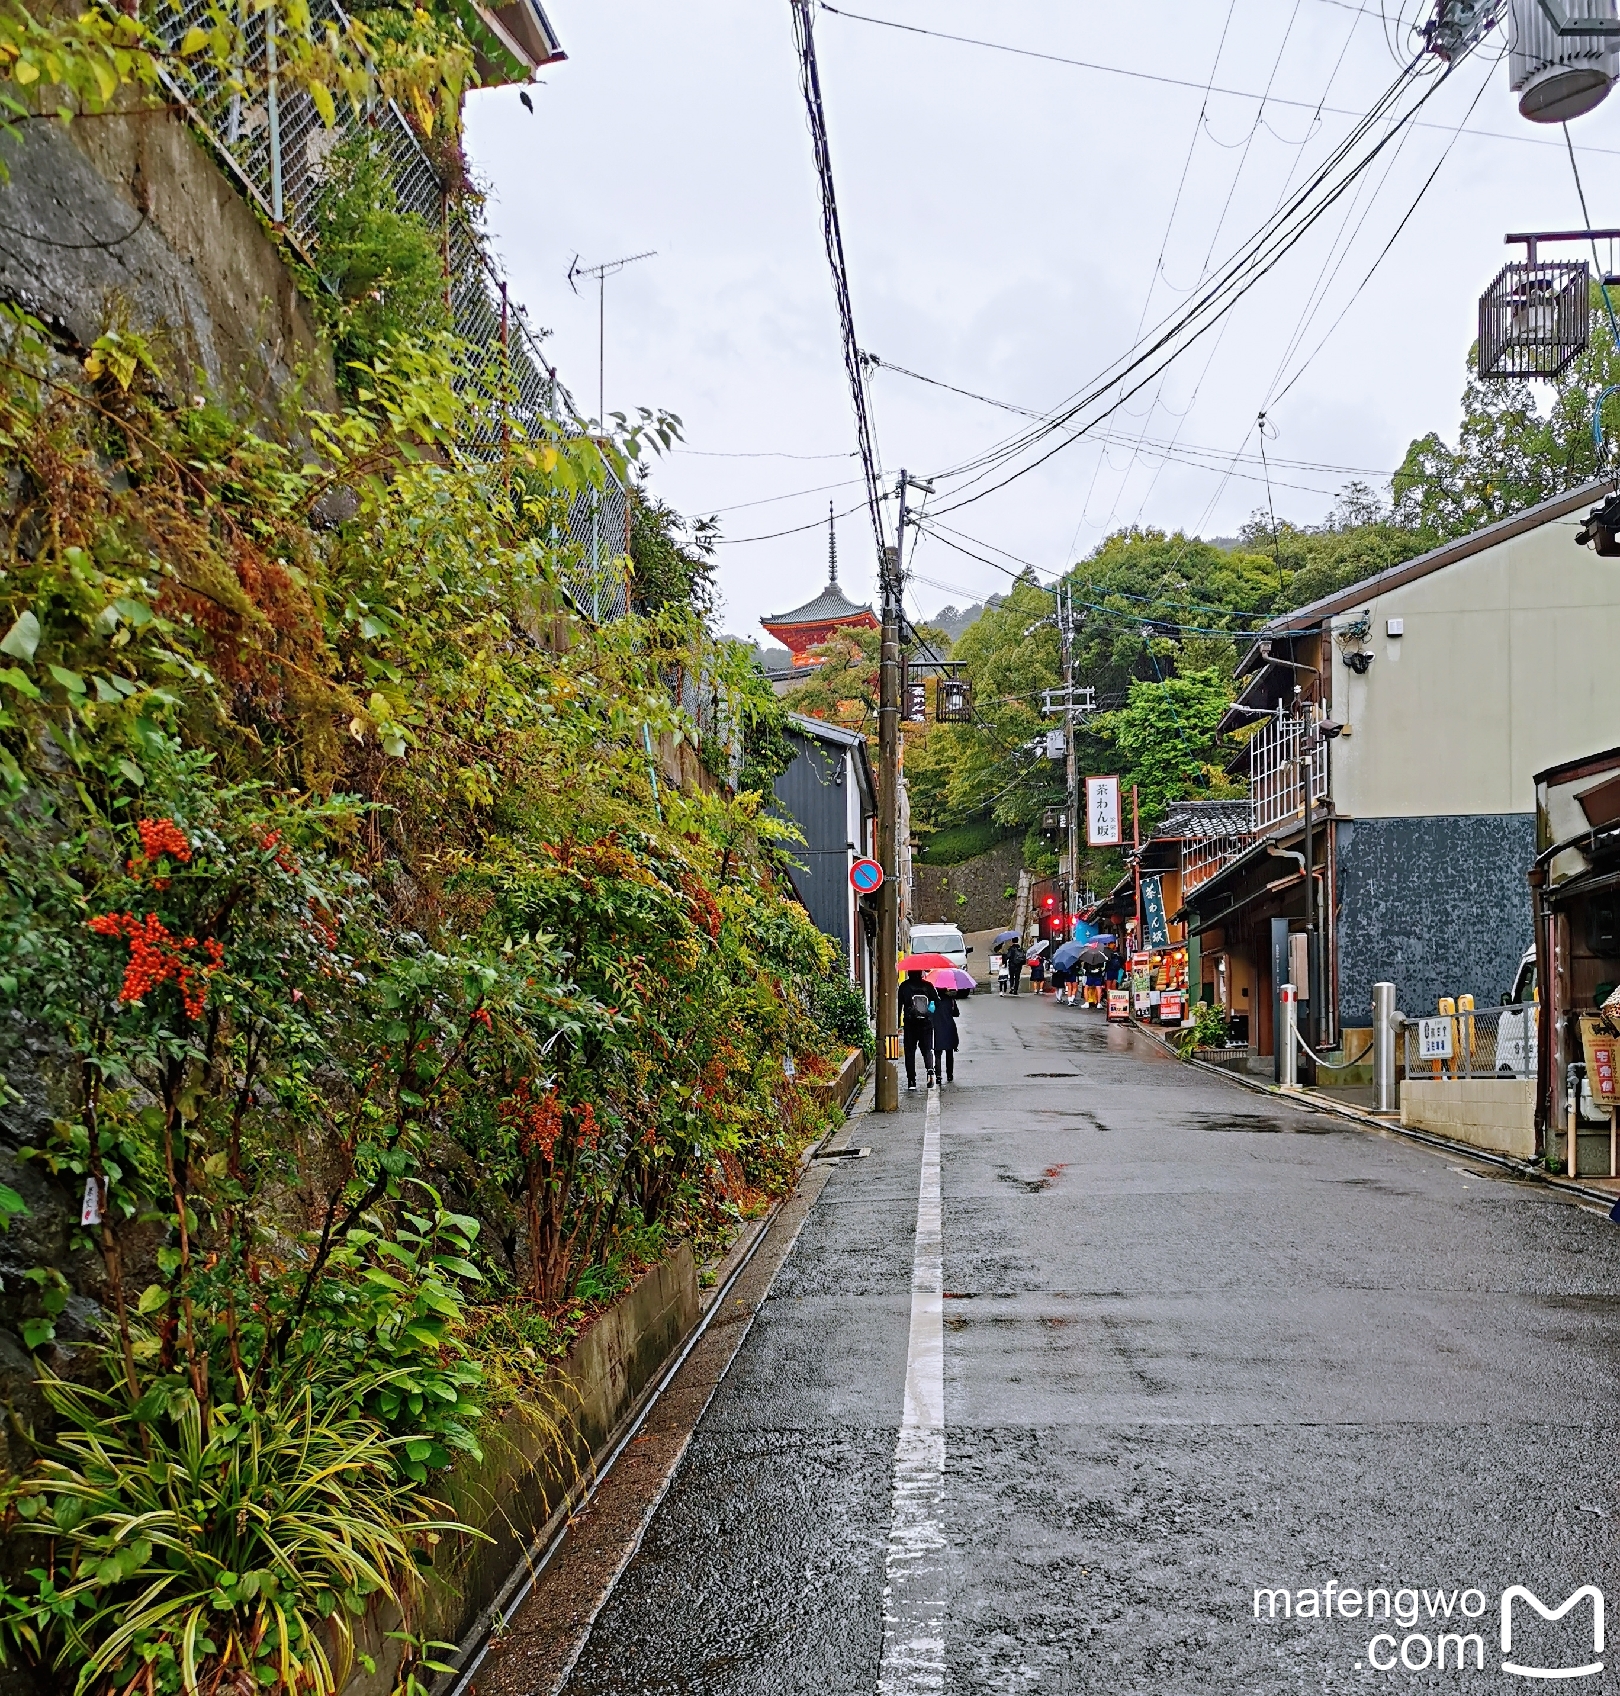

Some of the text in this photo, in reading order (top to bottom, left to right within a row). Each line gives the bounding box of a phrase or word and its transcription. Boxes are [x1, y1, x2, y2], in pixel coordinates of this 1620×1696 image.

[1096, 784, 1109, 836] 茶わん坂
[1145, 883, 1165, 943] 茶わん坂
[1596, 1050, 1613, 1092] 宅急便
